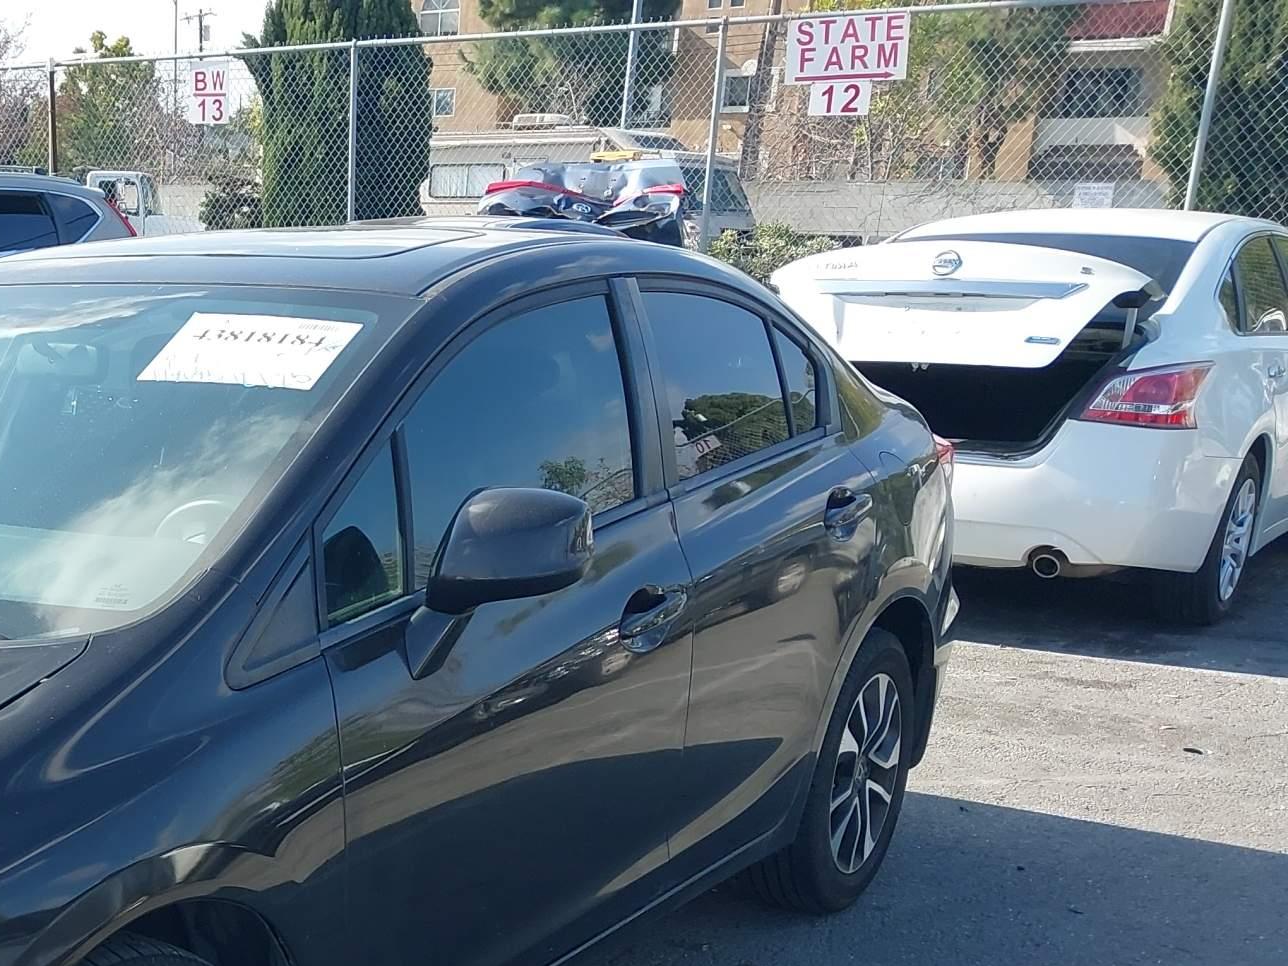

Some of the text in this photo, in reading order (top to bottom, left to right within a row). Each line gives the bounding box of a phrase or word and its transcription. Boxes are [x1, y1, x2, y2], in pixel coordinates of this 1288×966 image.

[796, 14, 905, 46] STATE
[799, 42, 898, 73] FARM
[194, 70, 225, 92] BW
[198, 98, 223, 122] 13
[821, 83, 860, 114] 12
